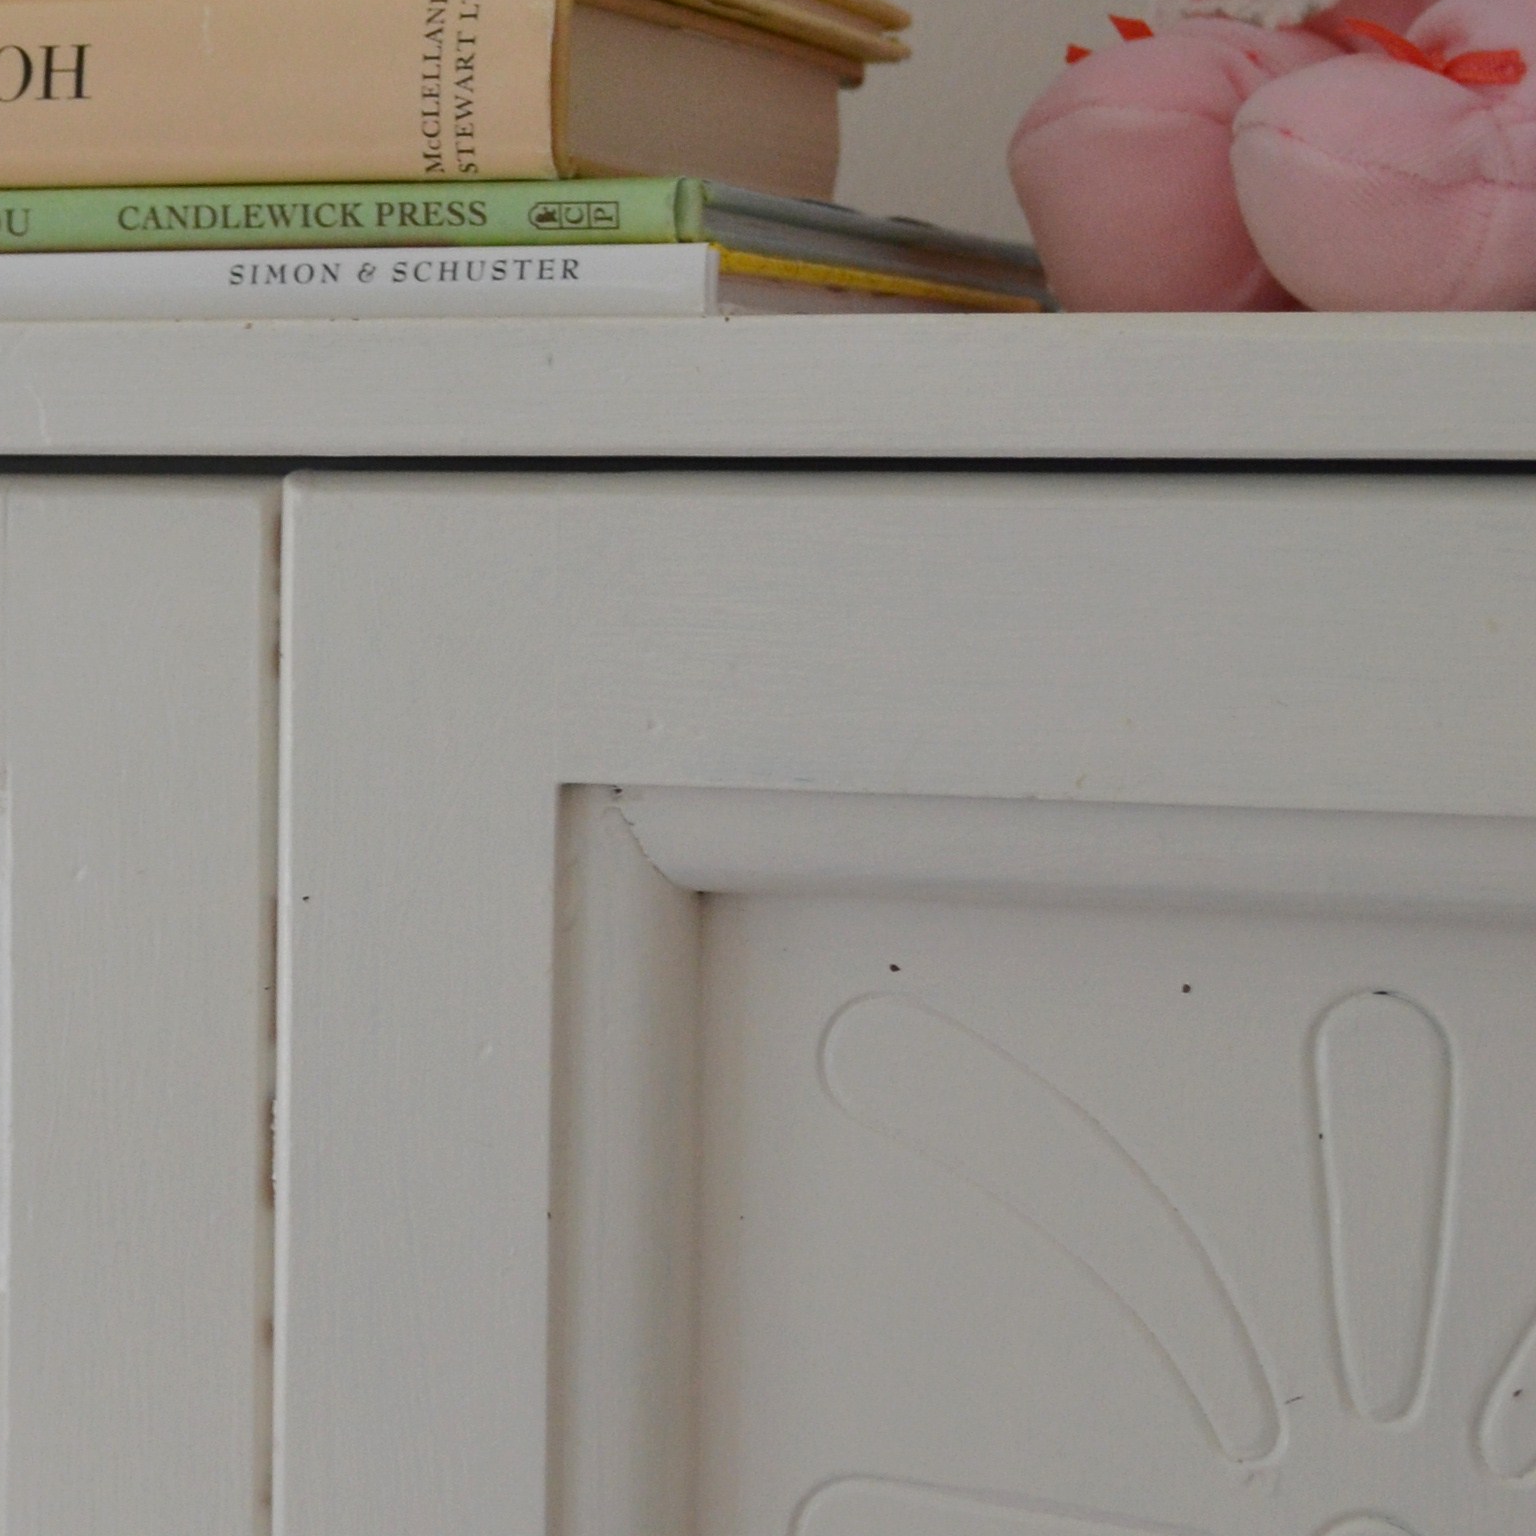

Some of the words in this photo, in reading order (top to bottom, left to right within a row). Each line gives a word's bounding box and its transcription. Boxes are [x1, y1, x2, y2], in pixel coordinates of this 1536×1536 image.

[454, 31, 478, 174] STEWART
[116, 202, 364, 232] CANDLEWICK
[375, 200, 487, 228] PRESS
[229, 261, 342, 286] SIMON
[357, 263, 378, 283] &
[392, 258, 581, 283] SCHUSTER
